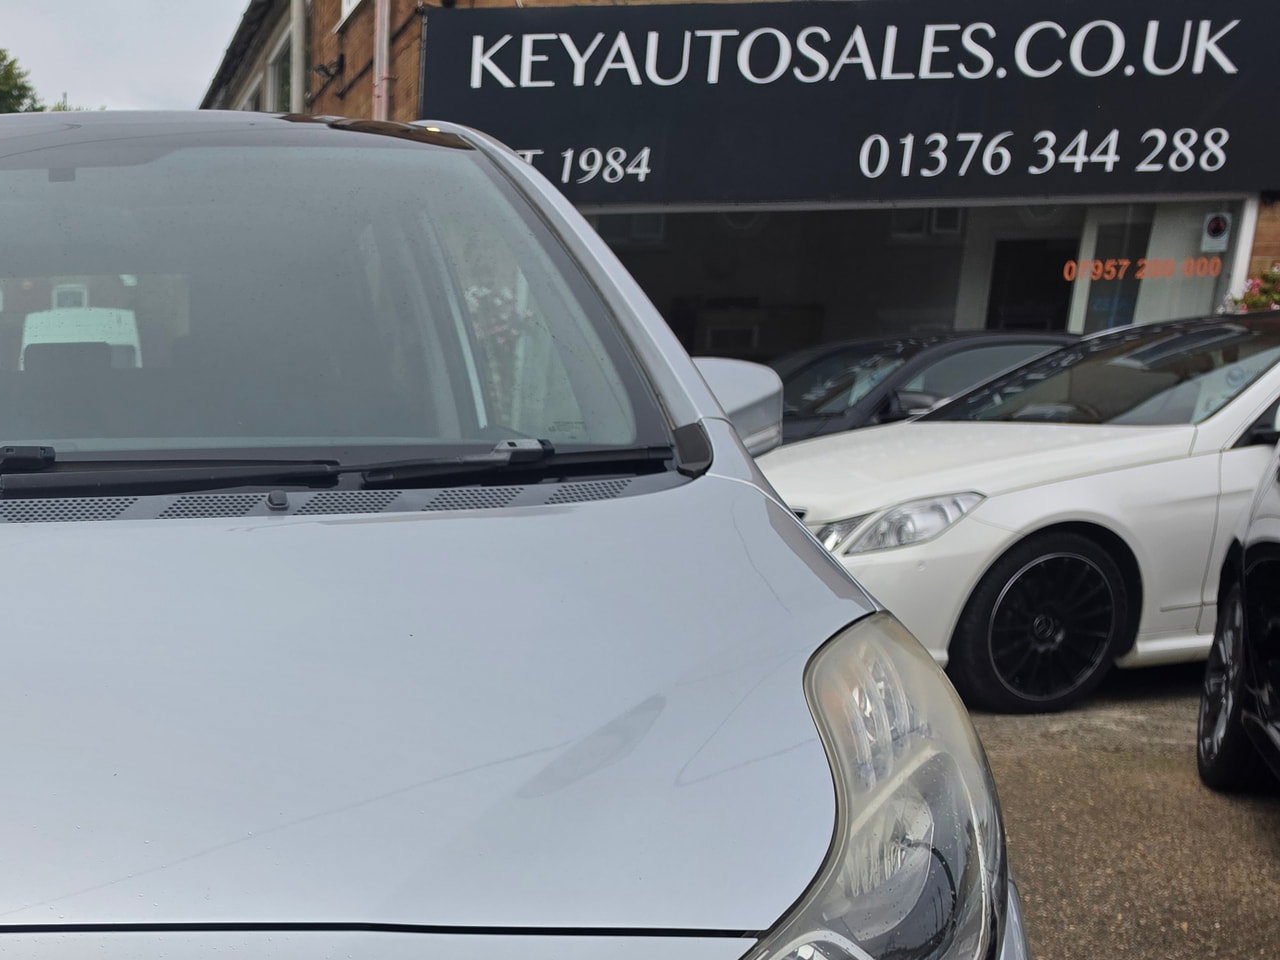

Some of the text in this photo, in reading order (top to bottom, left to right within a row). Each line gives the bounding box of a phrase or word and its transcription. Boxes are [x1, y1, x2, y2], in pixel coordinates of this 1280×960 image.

[470, 19, 1240, 88] KEYAUTOSALES.CO.UK
[560, 146, 652, 184] 1984
[858, 127, 1230, 178] 01376 344 288
[1063, 258, 1131, 281] 07957
